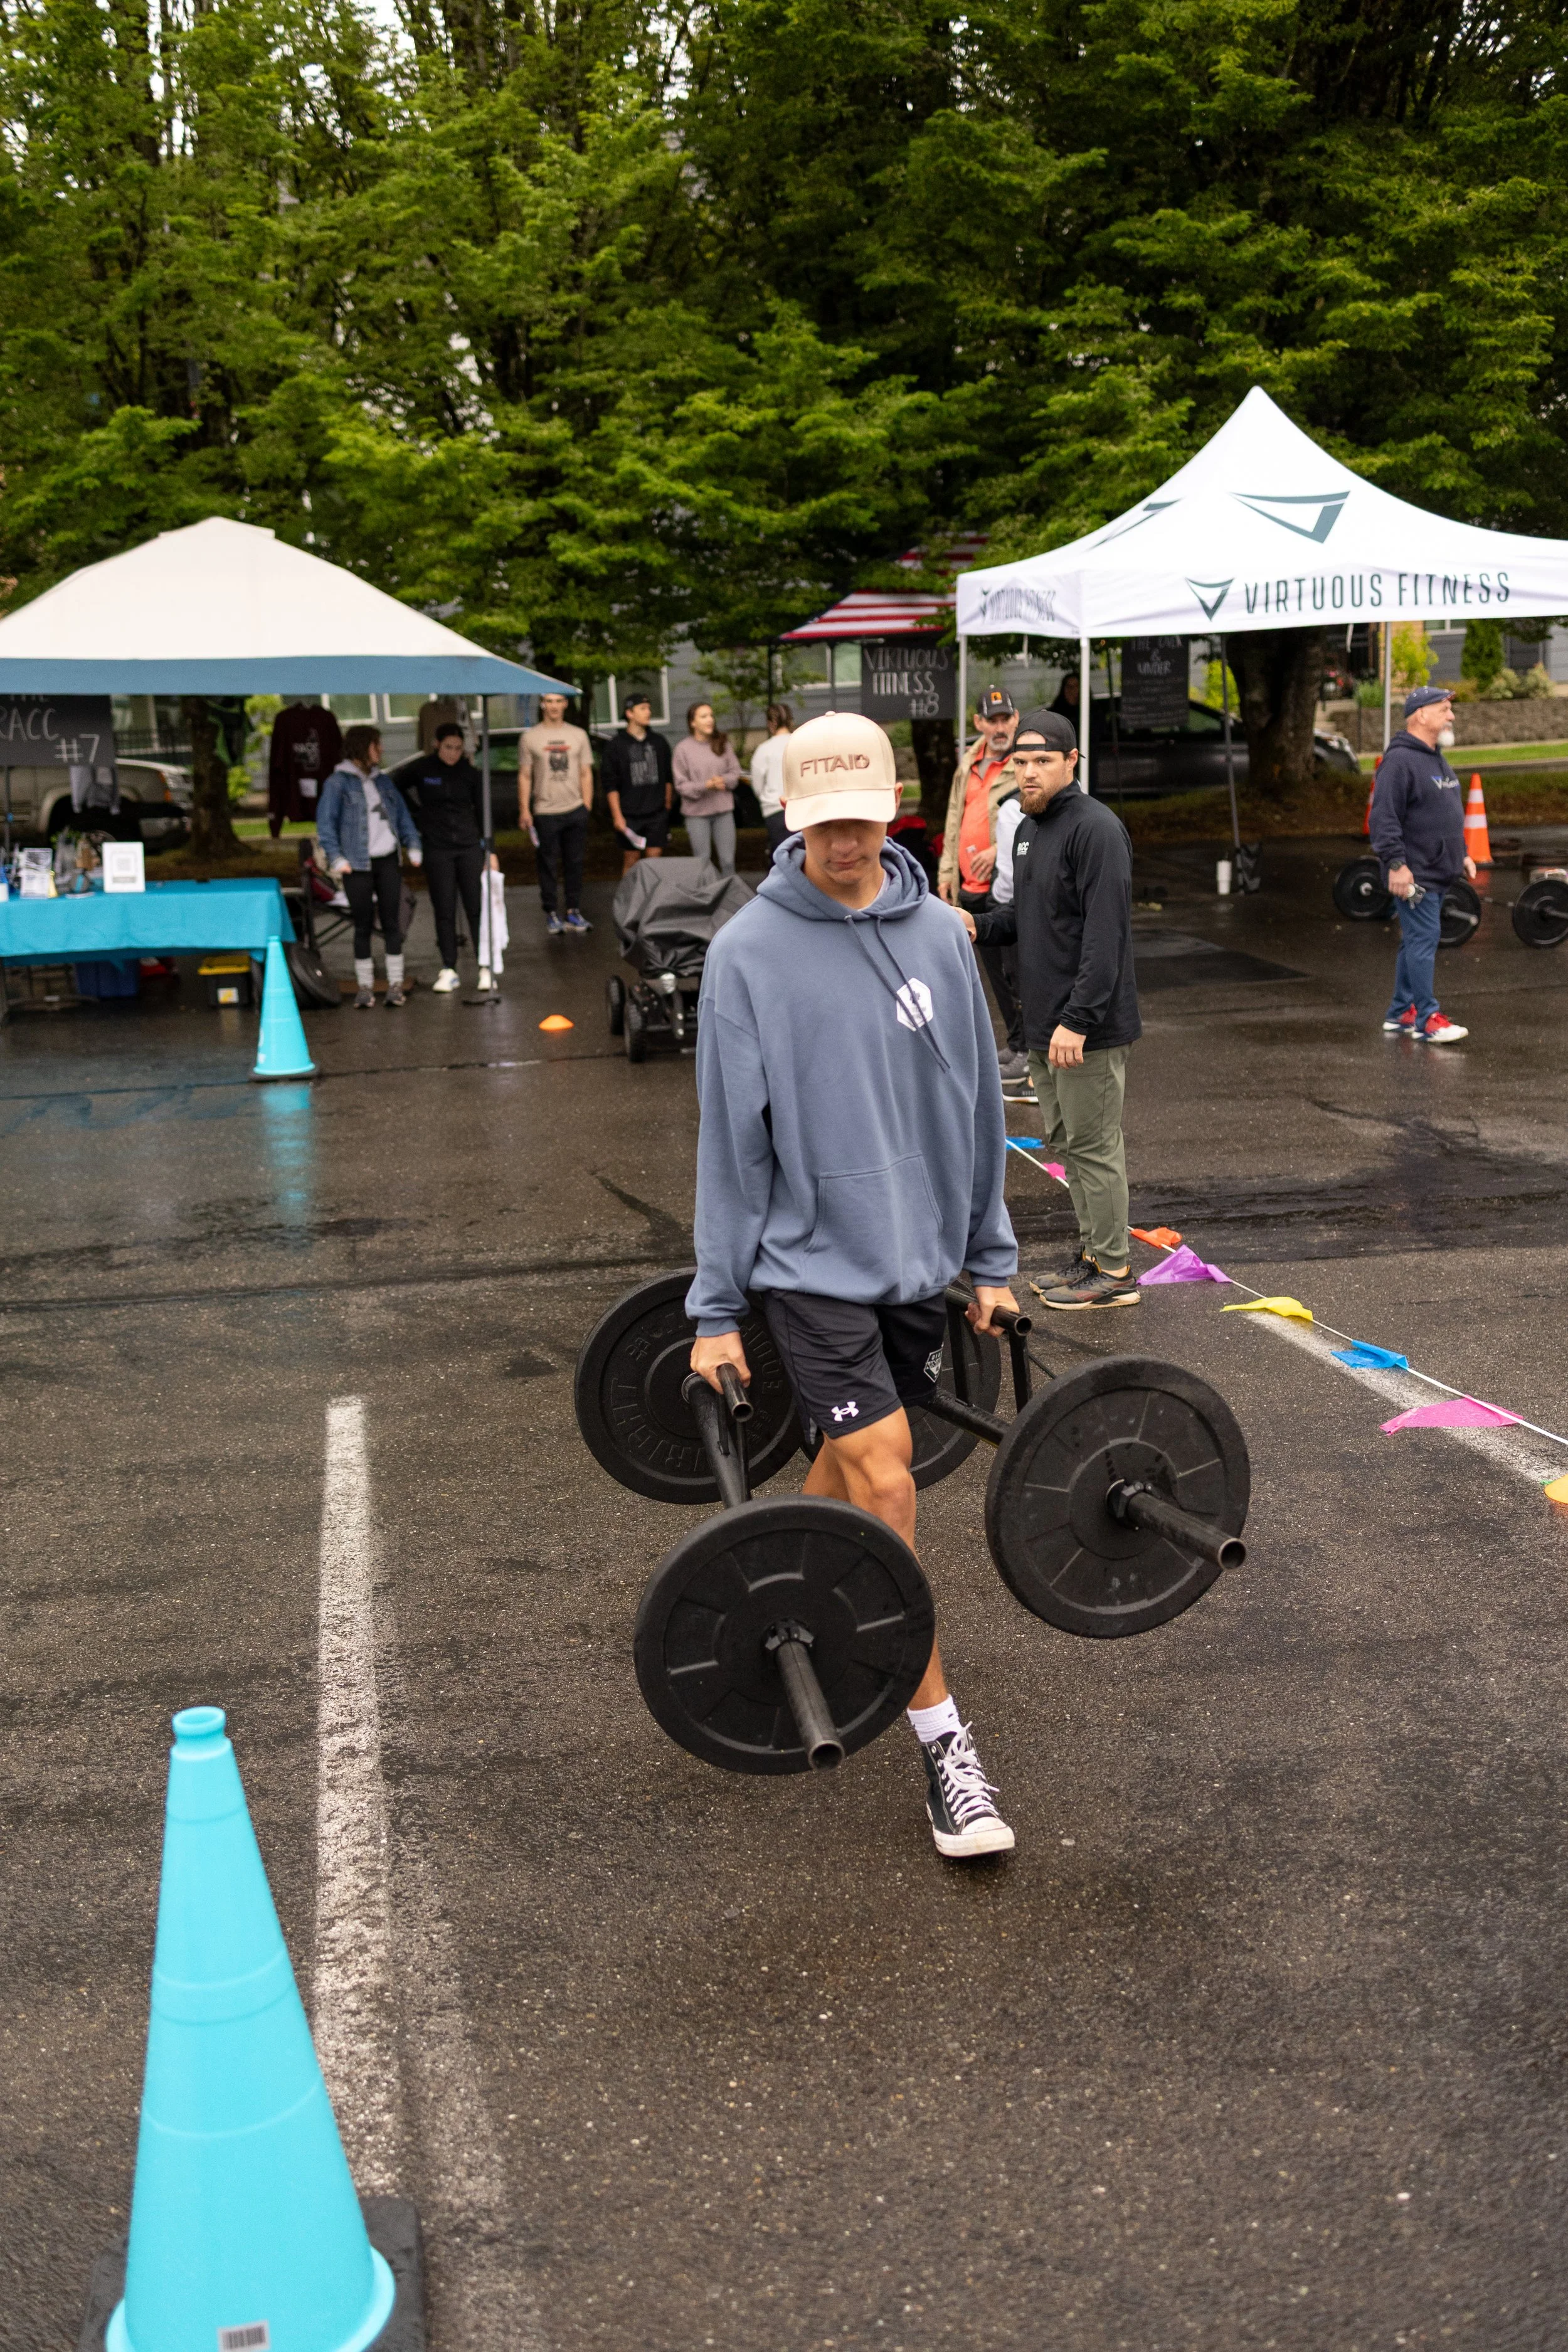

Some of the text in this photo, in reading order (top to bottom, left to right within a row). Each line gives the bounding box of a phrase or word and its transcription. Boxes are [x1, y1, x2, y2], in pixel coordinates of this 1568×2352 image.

[1244, 572, 1510, 613] VIRTUOUS FITNESS
[863, 647, 950, 671] VIRTUOUS
[910, 692, 940, 718] #8
[54, 733, 100, 764] #7
[800, 753, 870, 778] FITAID
